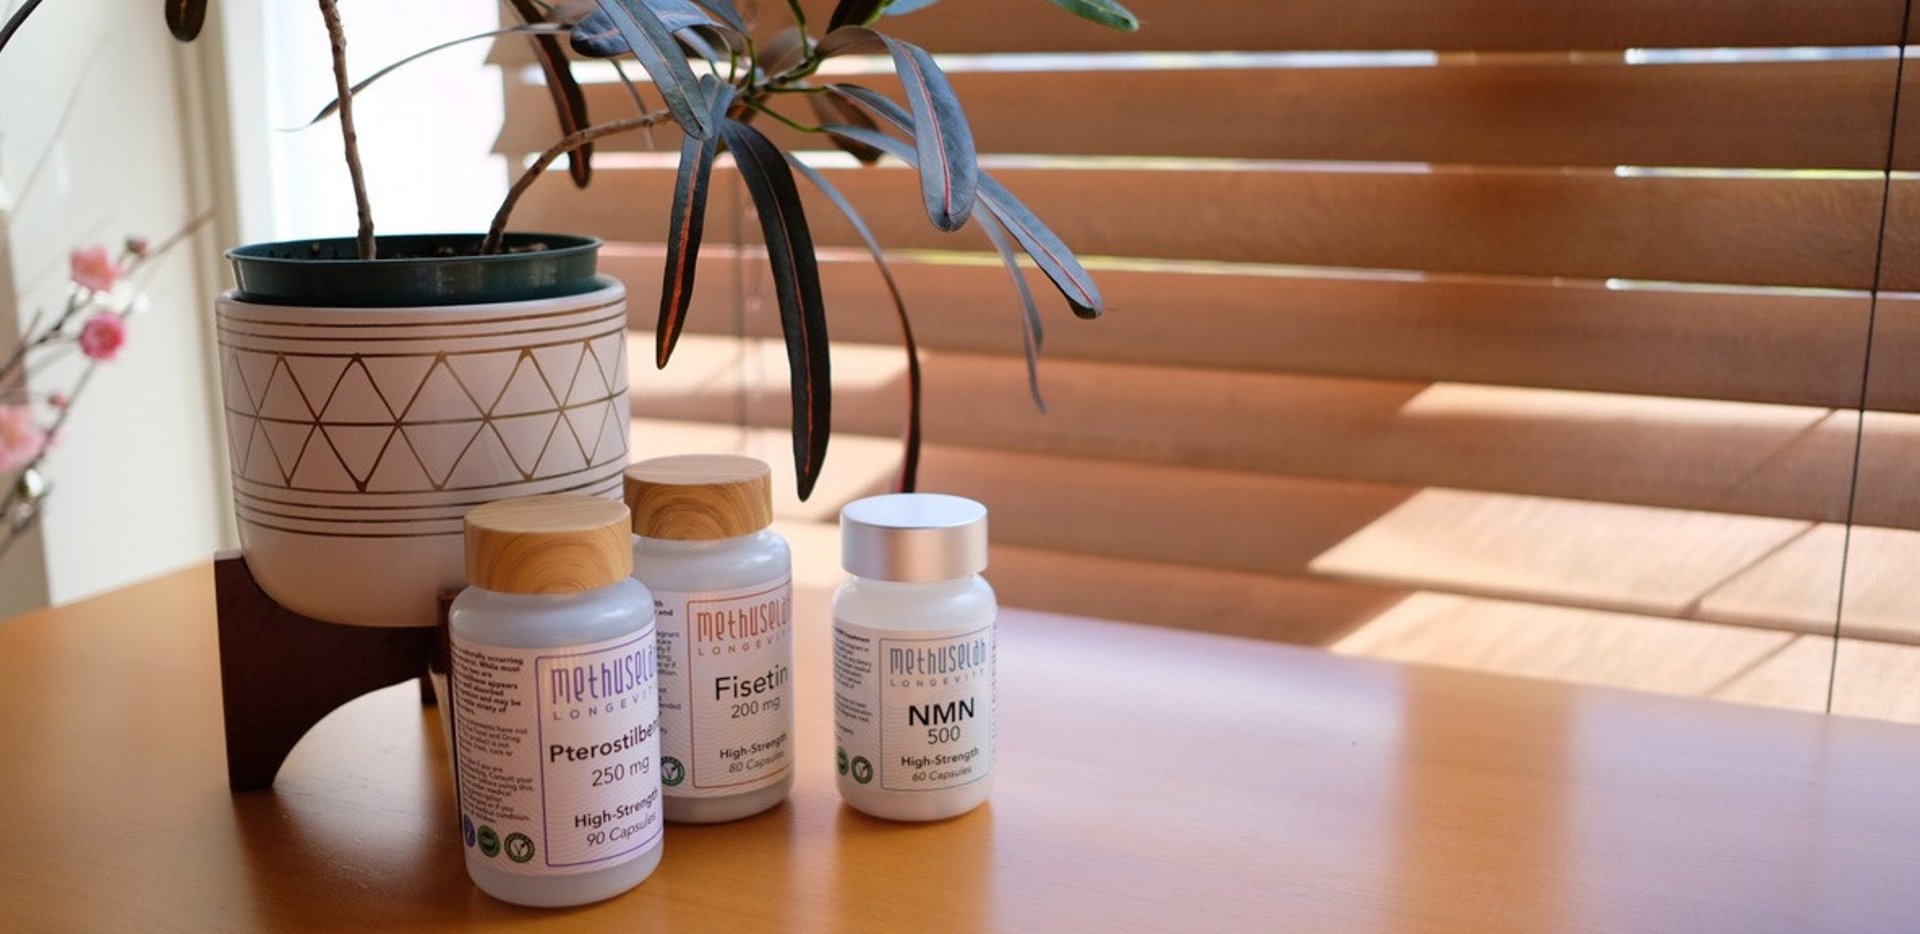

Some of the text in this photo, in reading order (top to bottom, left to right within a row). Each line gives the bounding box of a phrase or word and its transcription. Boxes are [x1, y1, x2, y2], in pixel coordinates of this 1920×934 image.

[699, 629, 787, 656] LONGEVIT
[715, 664, 788, 701] Fisetin
[890, 669, 985, 688] LONGEVITY
[553, 684, 653, 721] LONGEVIT
[731, 696, 781, 719] 200 mg
[908, 697, 975, 726] NMN
[719, 732, 787, 760] High-Strength
[927, 725, 961, 745] 500
[591, 763, 625, 787] 250
[629, 754, 650, 779] mg
[729, 751, 785, 773] 80 Capsules
[901, 747, 979, 768] High-Strength
[912, 766, 972, 782] 60 Capsules
[574, 786, 658, 829] High-Strength
[586, 811, 657, 847] 90 Capsules
